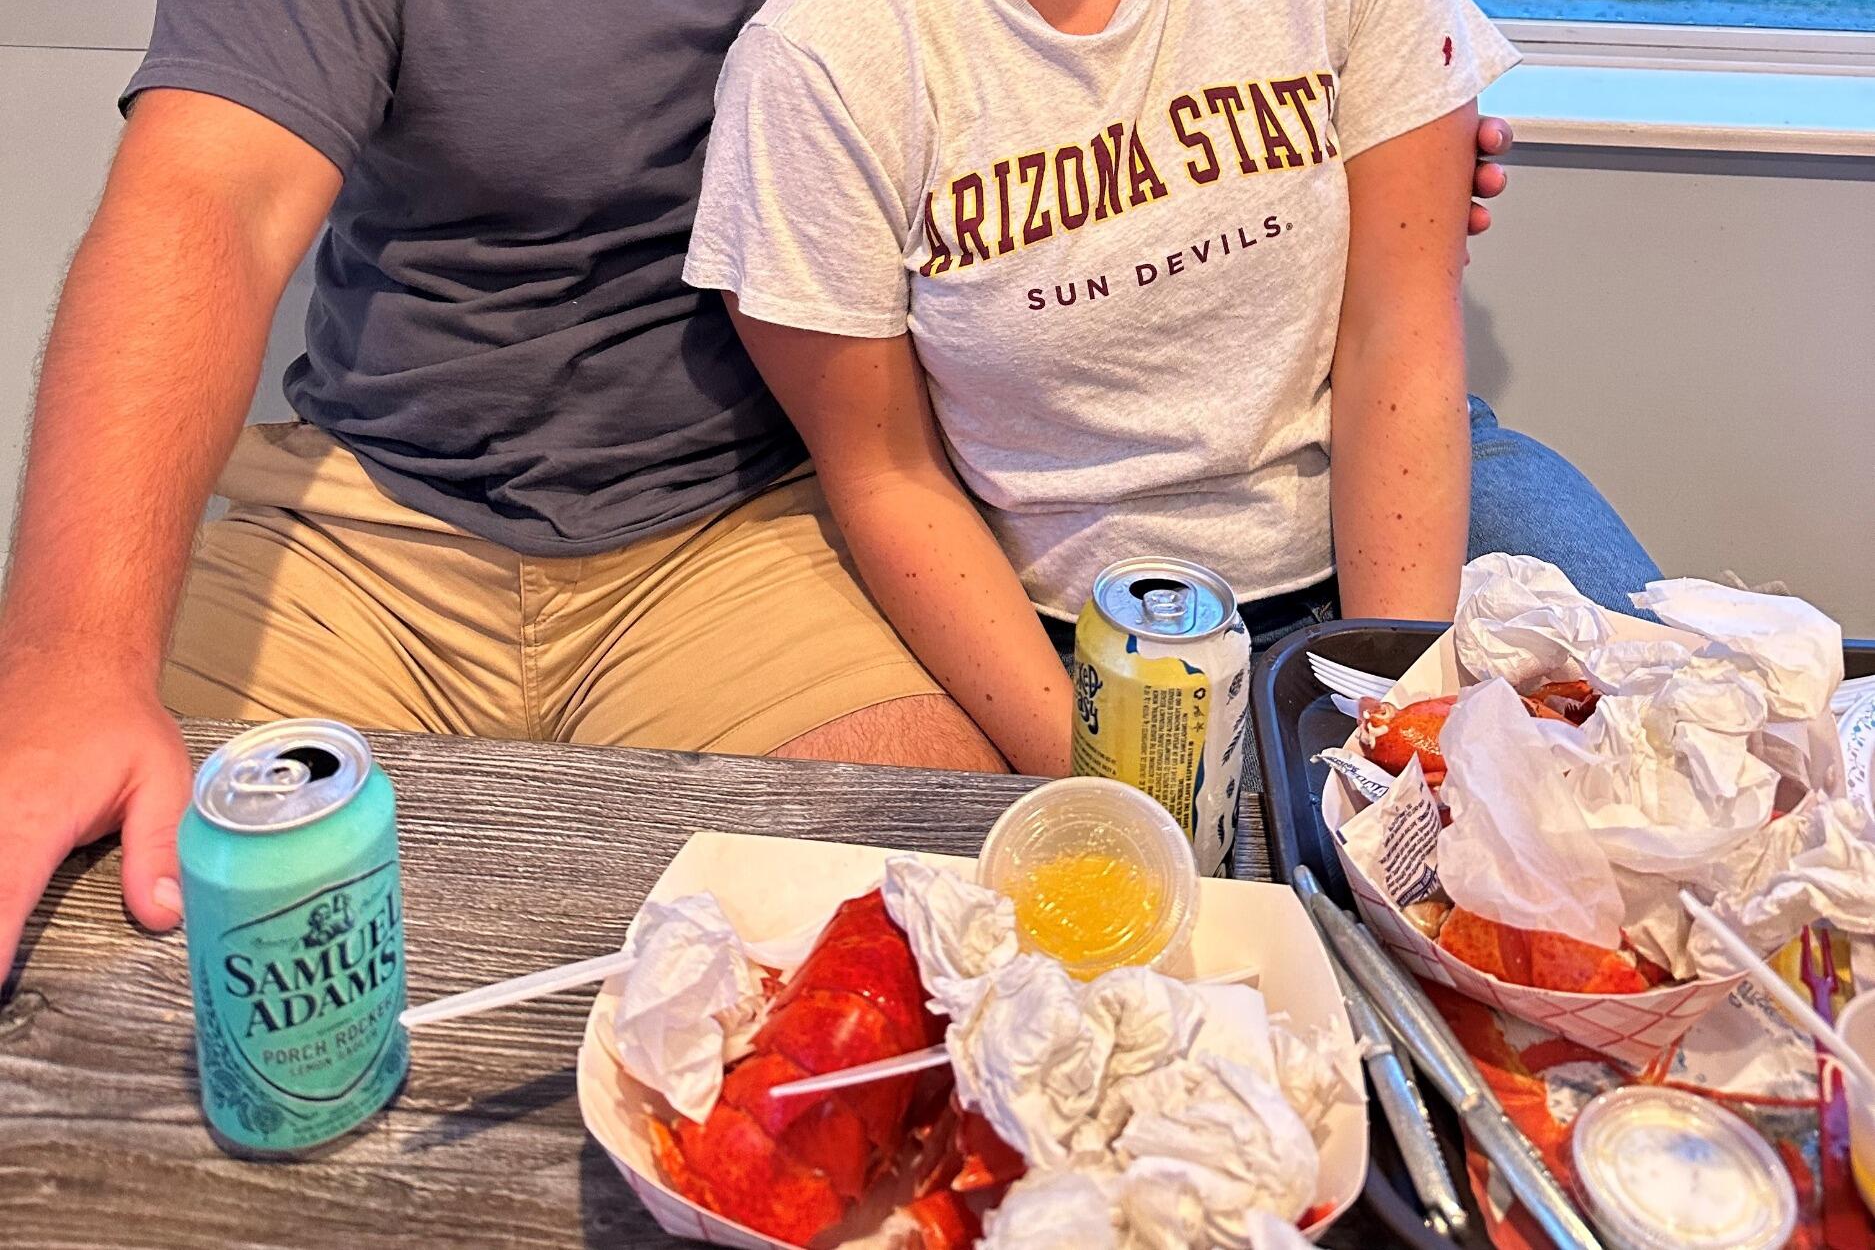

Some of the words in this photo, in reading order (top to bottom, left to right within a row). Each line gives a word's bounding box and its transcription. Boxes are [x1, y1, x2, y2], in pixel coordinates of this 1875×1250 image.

[920, 118, 1167, 277] ARIZONA
[1027, 275, 1110, 311] SUN
[225, 889, 401, 998] SAMUEL
[244, 940, 398, 1039] ADAMS
[263, 1040, 328, 1066] PORCH
[335, 1000, 394, 1046] ROCKER
